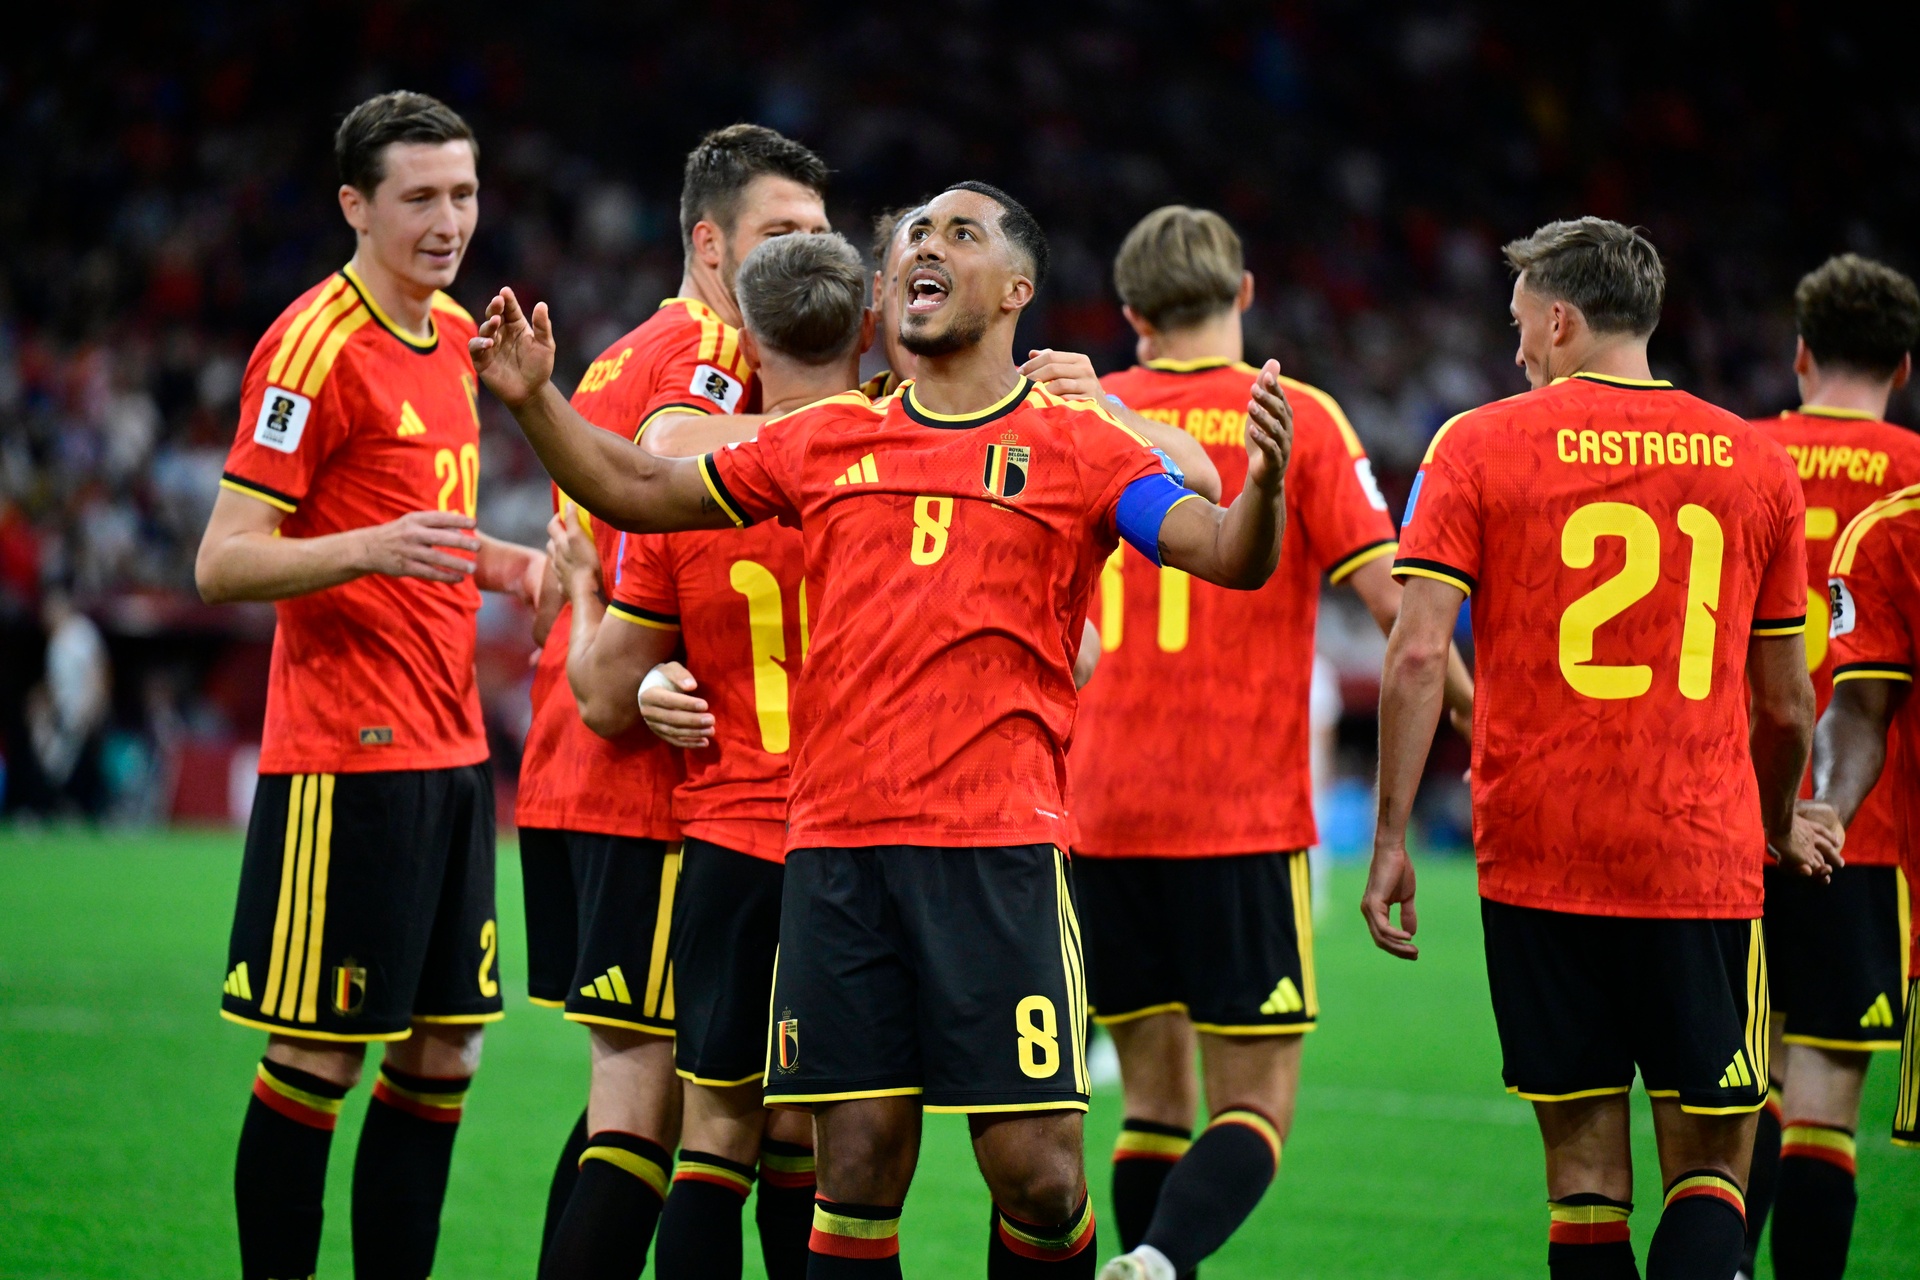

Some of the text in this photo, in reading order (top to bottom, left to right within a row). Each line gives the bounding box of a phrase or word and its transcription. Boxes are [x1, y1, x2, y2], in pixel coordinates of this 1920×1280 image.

[434, 442, 480, 519] 20
[1557, 428, 1734, 467] CASTAGNE
[910, 495, 954, 566] 8
[1559, 502, 1724, 700] 21
[478, 919, 498, 998] 2
[1015, 994, 1060, 1079] 8
